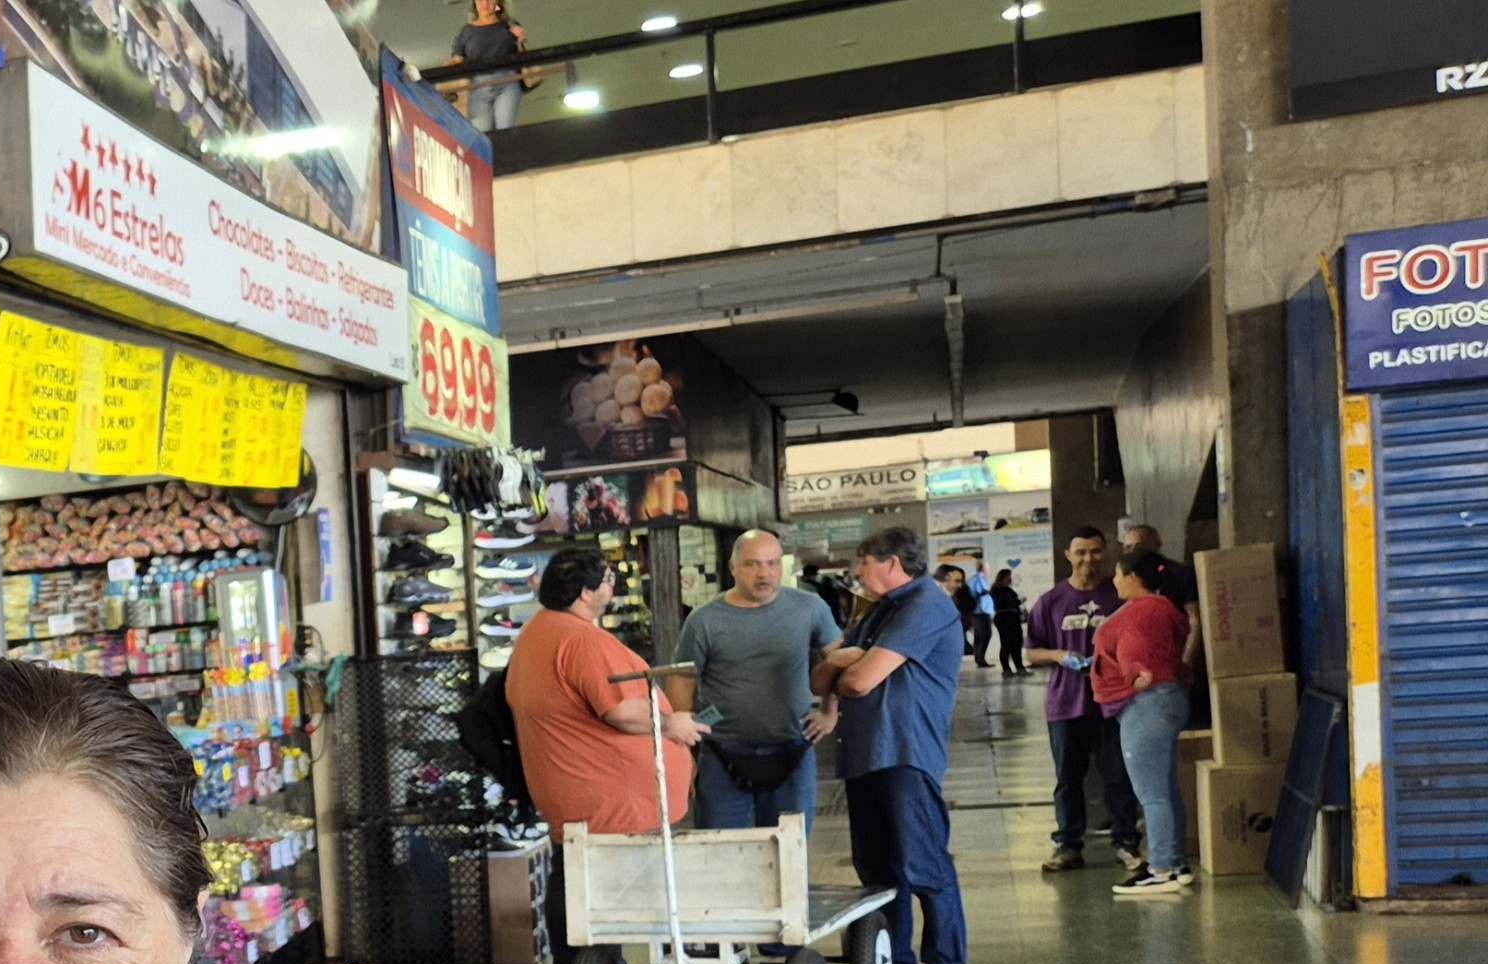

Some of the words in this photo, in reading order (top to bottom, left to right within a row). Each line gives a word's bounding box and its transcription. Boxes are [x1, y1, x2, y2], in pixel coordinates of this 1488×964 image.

[413, 123, 475, 232] PROMOÇÃO
[45, 213, 69, 244] Mini
[72, 224, 118, 267] Mercado
[110, 188, 184, 266] Estrelas
[208, 199, 276, 262] Chocolates
[286, 238, 328, 284] Biscoitos
[337, 261, 395, 310] Refrigerantes
[240, 266, 275, 311] Doces
[286, 286, 330, 331] Balinhas
[339, 306, 378, 346] Salgados
[840, 469, 917, 488] PAULO
